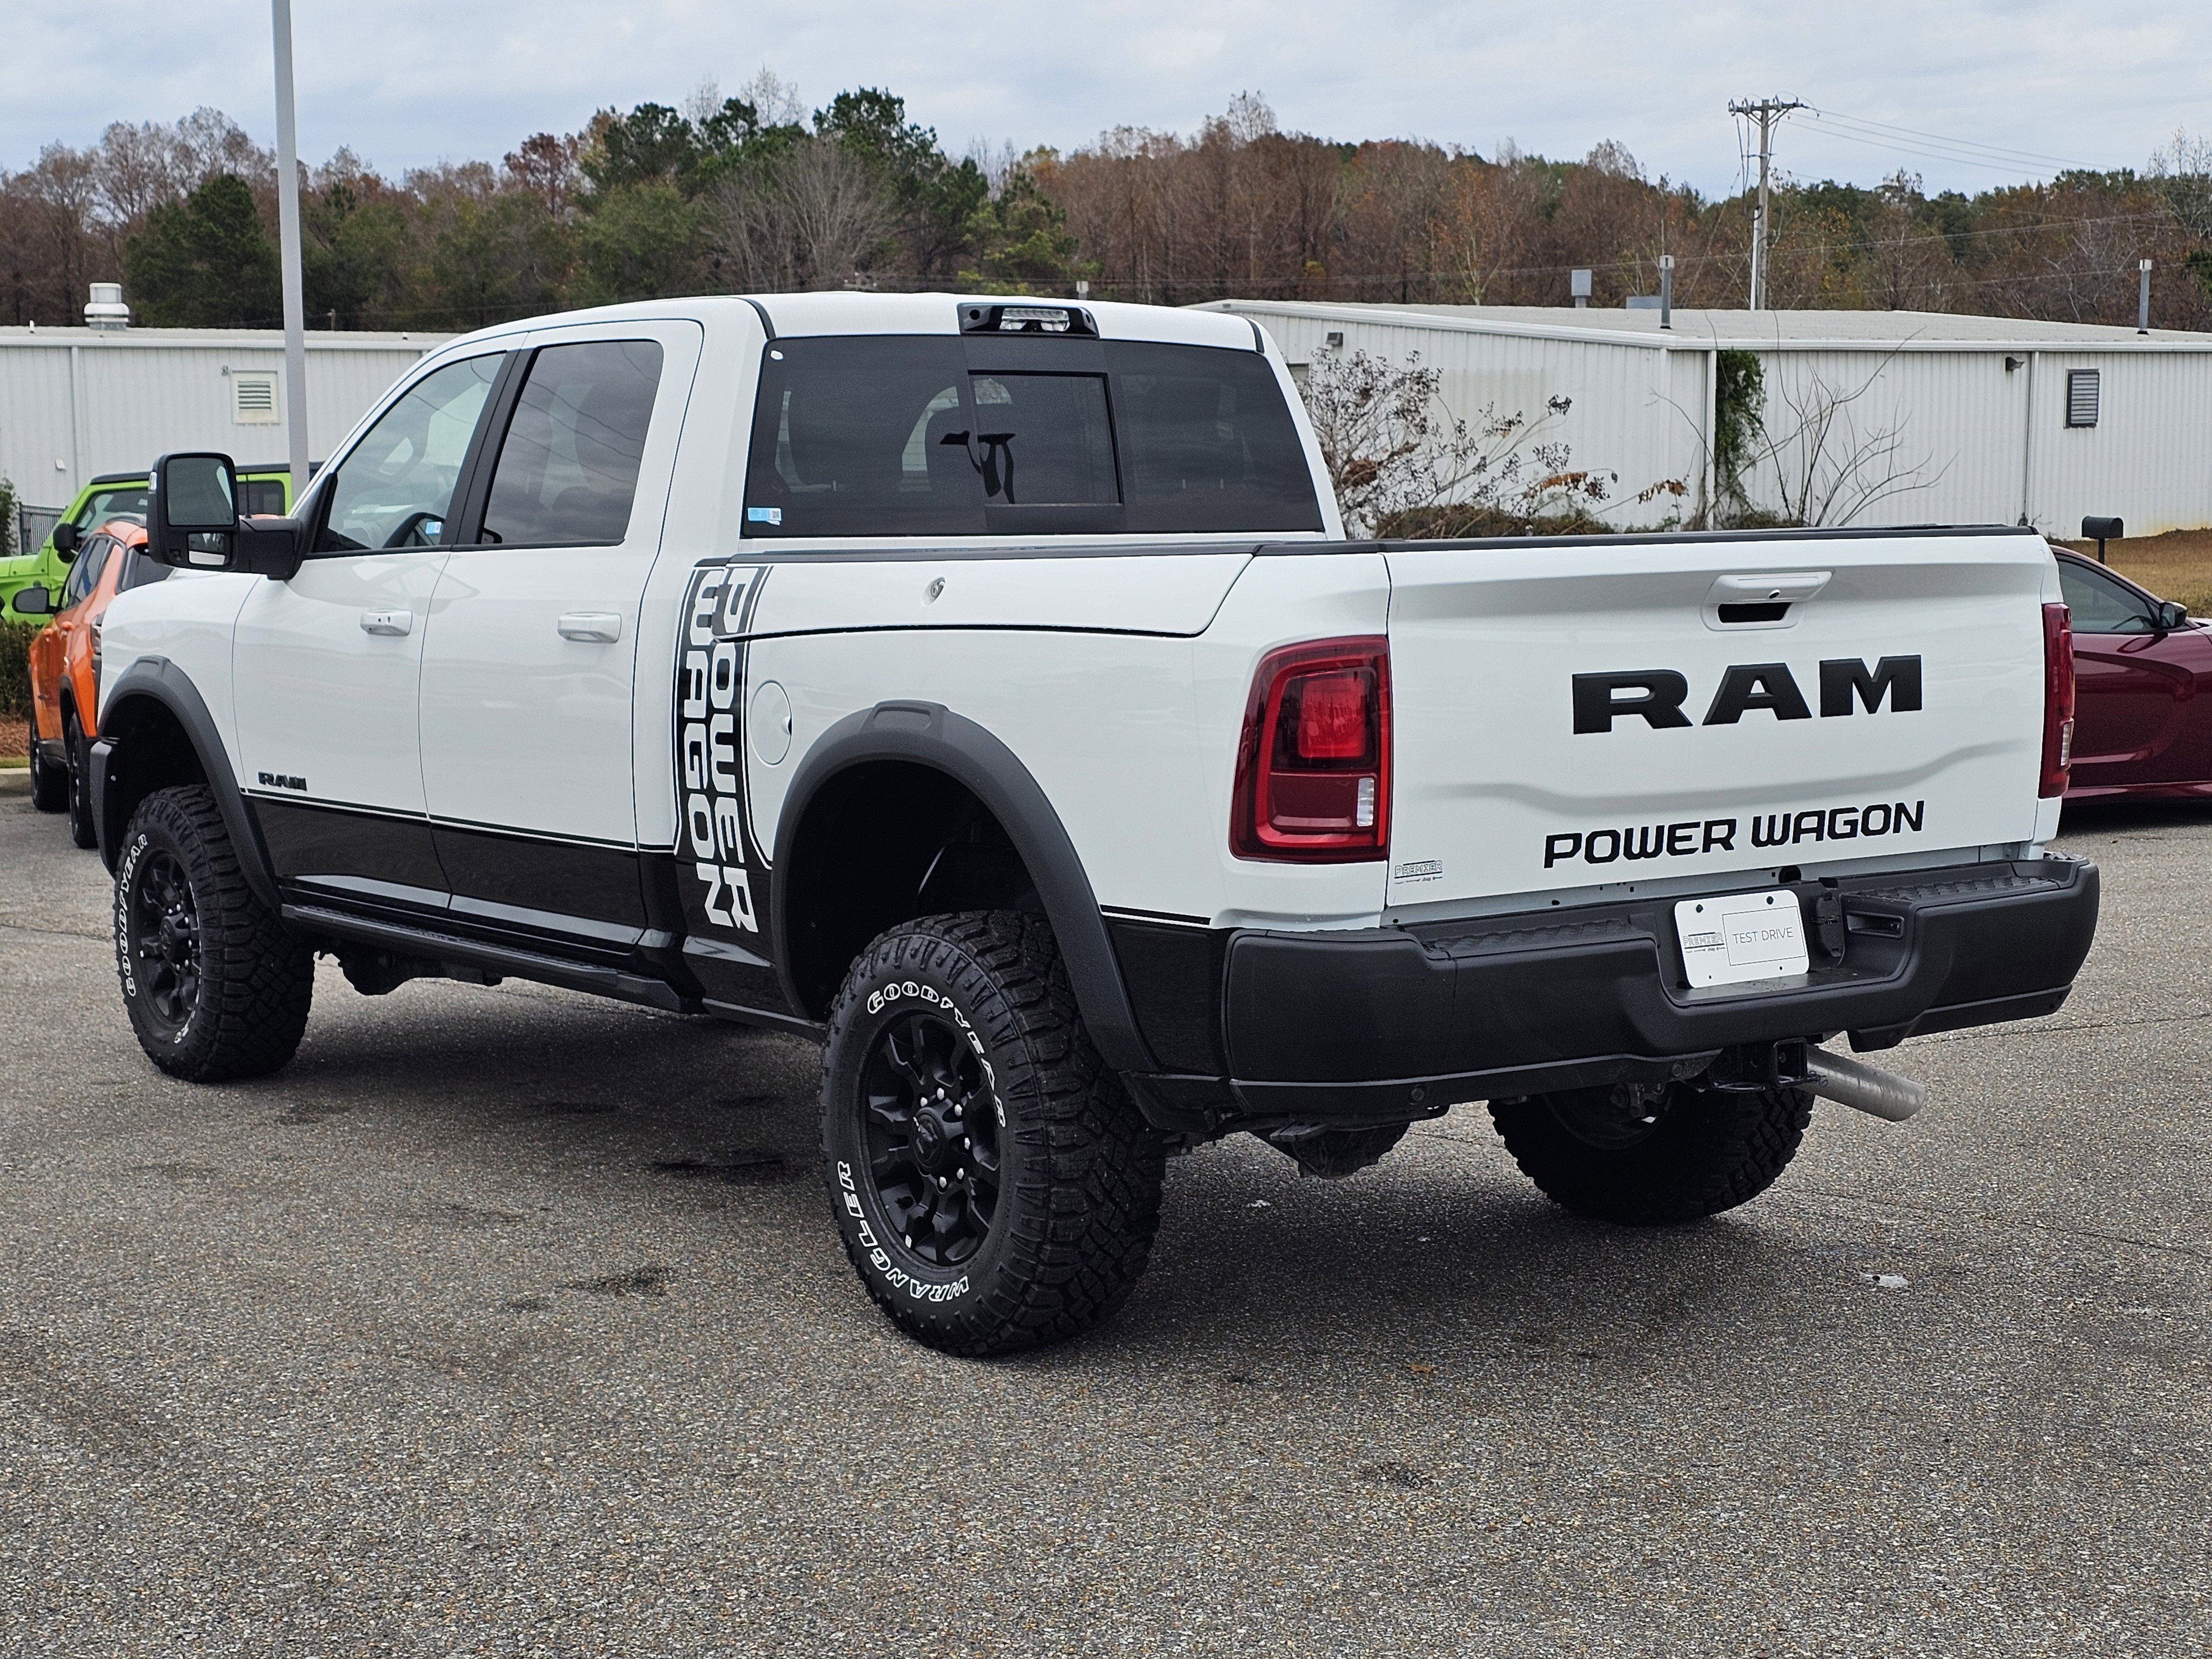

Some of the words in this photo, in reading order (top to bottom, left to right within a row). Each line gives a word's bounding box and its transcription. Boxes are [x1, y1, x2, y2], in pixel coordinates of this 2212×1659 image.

[1572, 654, 1923, 735] RAM
[258, 771, 307, 791] RAM
[684, 569, 733, 928] WAGON
[710, 567, 758, 933] POWER
[1395, 860, 1442, 876] PREMIER
[1543, 817, 1738, 868] POWER
[1751, 800, 1924, 847] WAGON
[119, 834, 148, 997] GOODYEAR
[1682, 932, 1724, 946] PREMIER
[1732, 932, 1758, 944] TEST
[1762, 927, 1794, 940] DRIVE
[867, 982, 1006, 1128] GOODYEAR
[837, 1161, 969, 1302] WRANGLER
